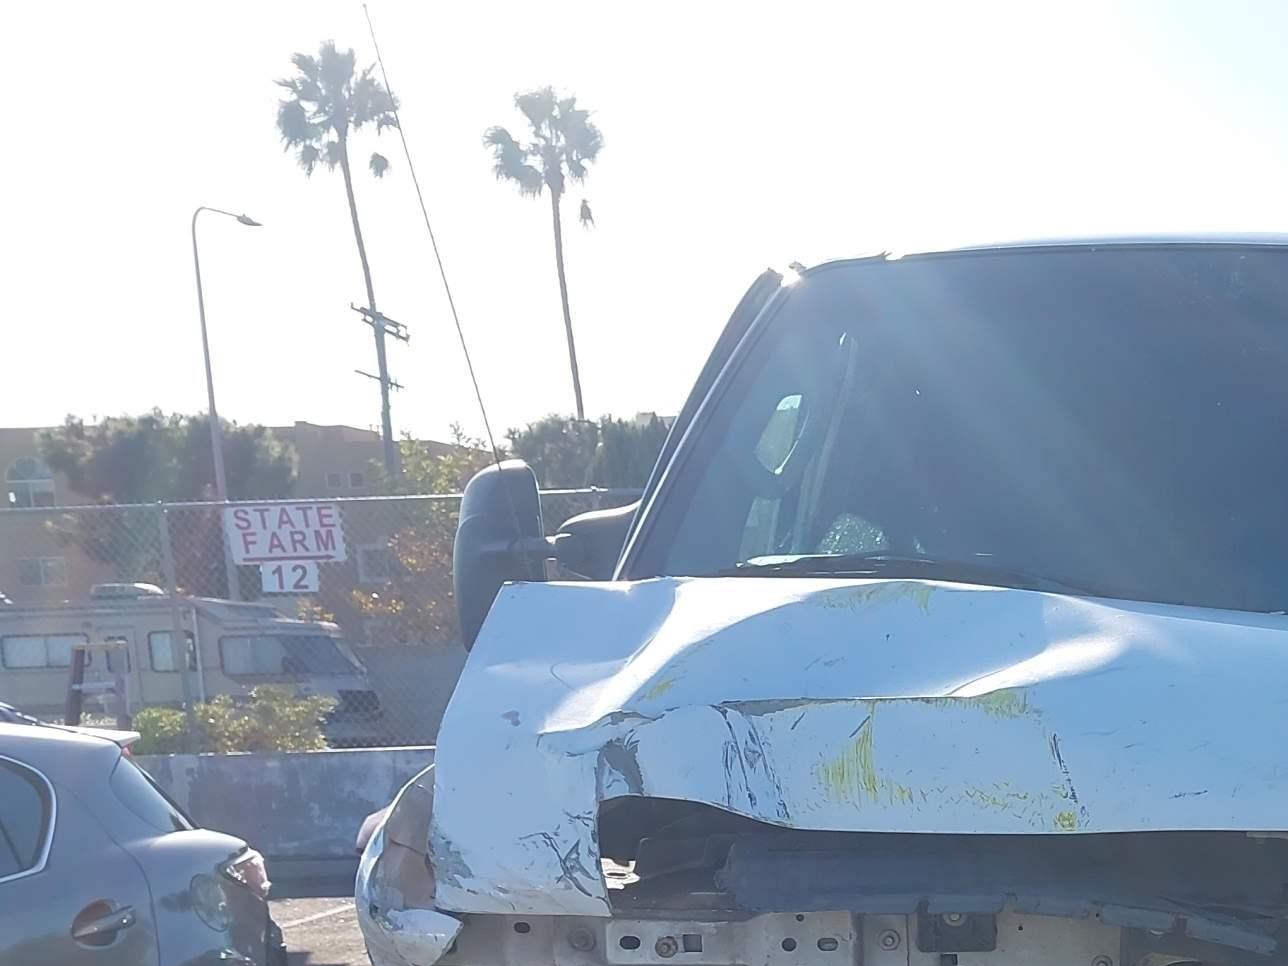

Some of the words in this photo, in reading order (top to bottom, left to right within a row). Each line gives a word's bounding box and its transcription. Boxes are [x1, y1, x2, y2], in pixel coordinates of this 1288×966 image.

[233, 506, 337, 531] STATE
[241, 529, 337, 555] FARM
[271, 564, 309, 590] 12
